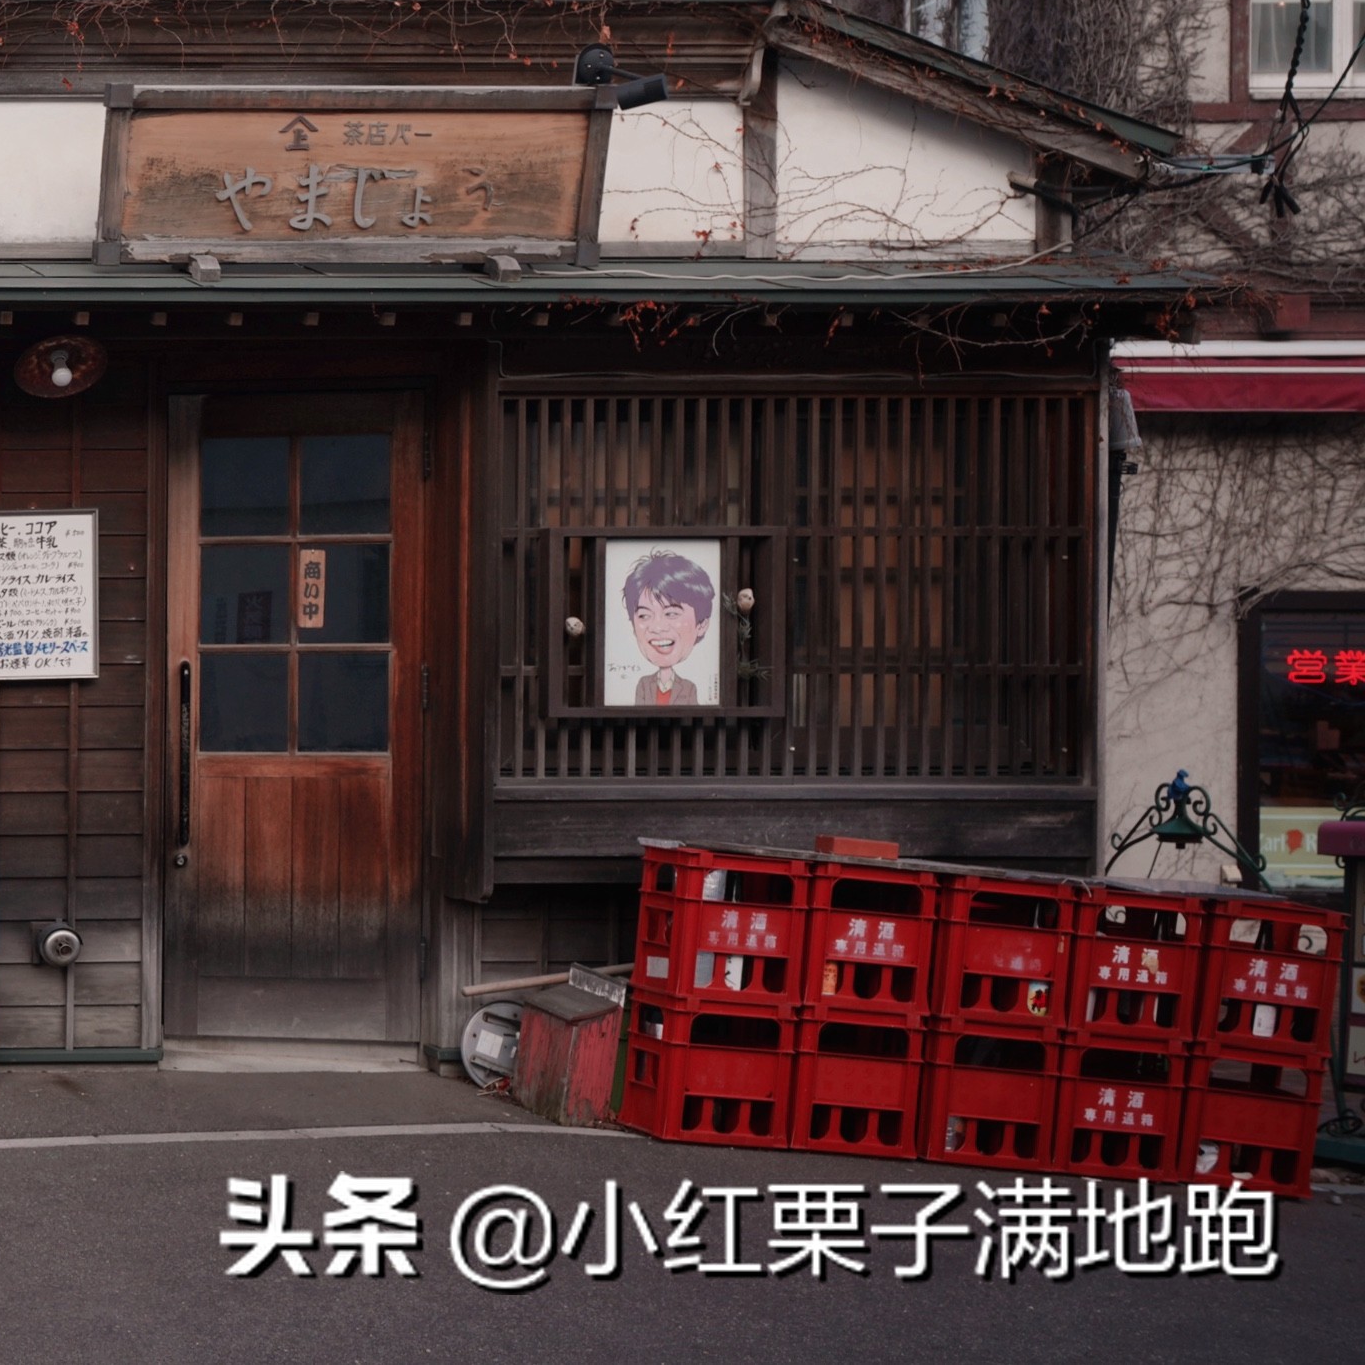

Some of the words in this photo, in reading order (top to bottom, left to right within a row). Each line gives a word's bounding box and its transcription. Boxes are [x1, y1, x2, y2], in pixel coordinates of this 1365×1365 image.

[343, 121, 433, 147] 茶店バー
[303, 561, 321, 620] 商い中
[1287, 649, 1365, 686] 営業
[721, 909, 768, 931] 清酒
[849, 918, 896, 940] 清酒
[1098, 966, 1168, 984] 専用通箱
[1248, 958, 1299, 981] 清酒
[1233, 978, 1308, 999] 専用通箱
[1098, 1087, 1145, 1108] 清酒
[1084, 1108, 1154, 1126] 専用通箱
